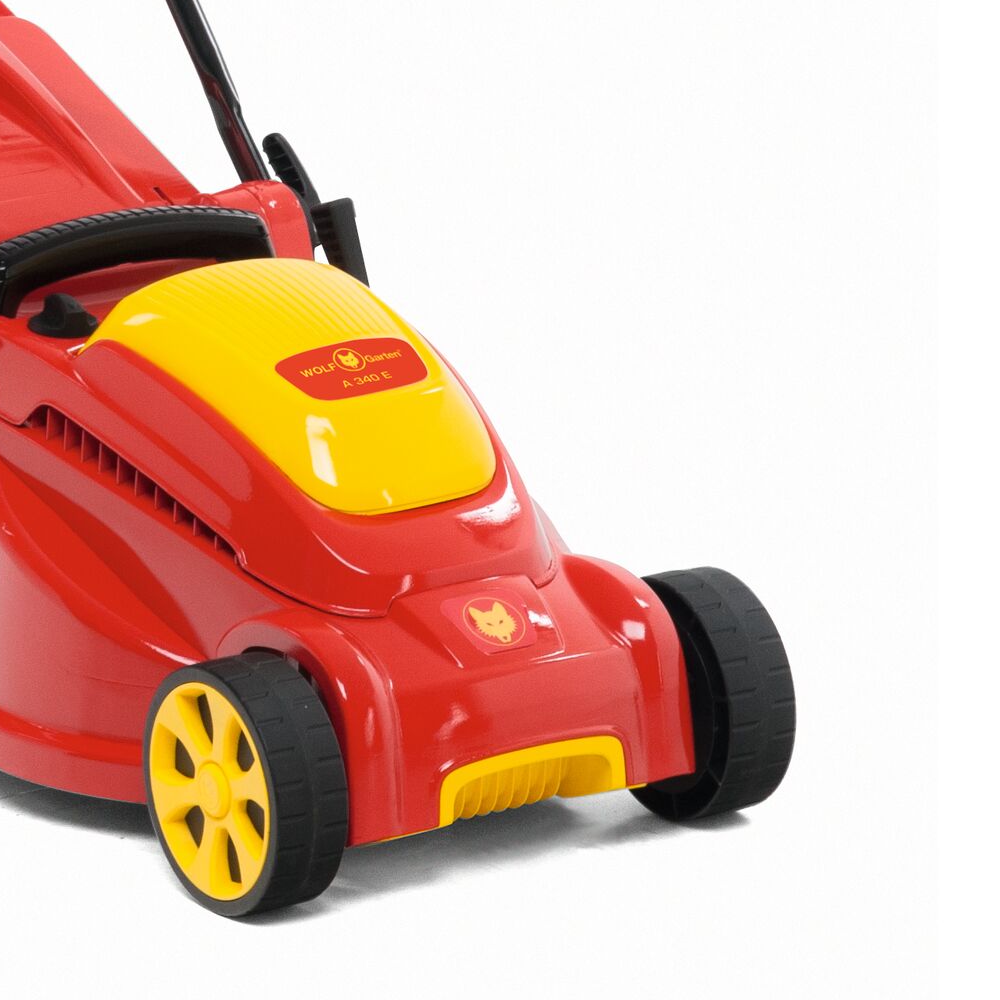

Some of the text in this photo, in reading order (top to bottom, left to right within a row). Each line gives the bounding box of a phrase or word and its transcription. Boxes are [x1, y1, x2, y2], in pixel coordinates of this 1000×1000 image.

[300, 362, 337, 378] WOLF
[342, 370, 393, 388] A 340 E
